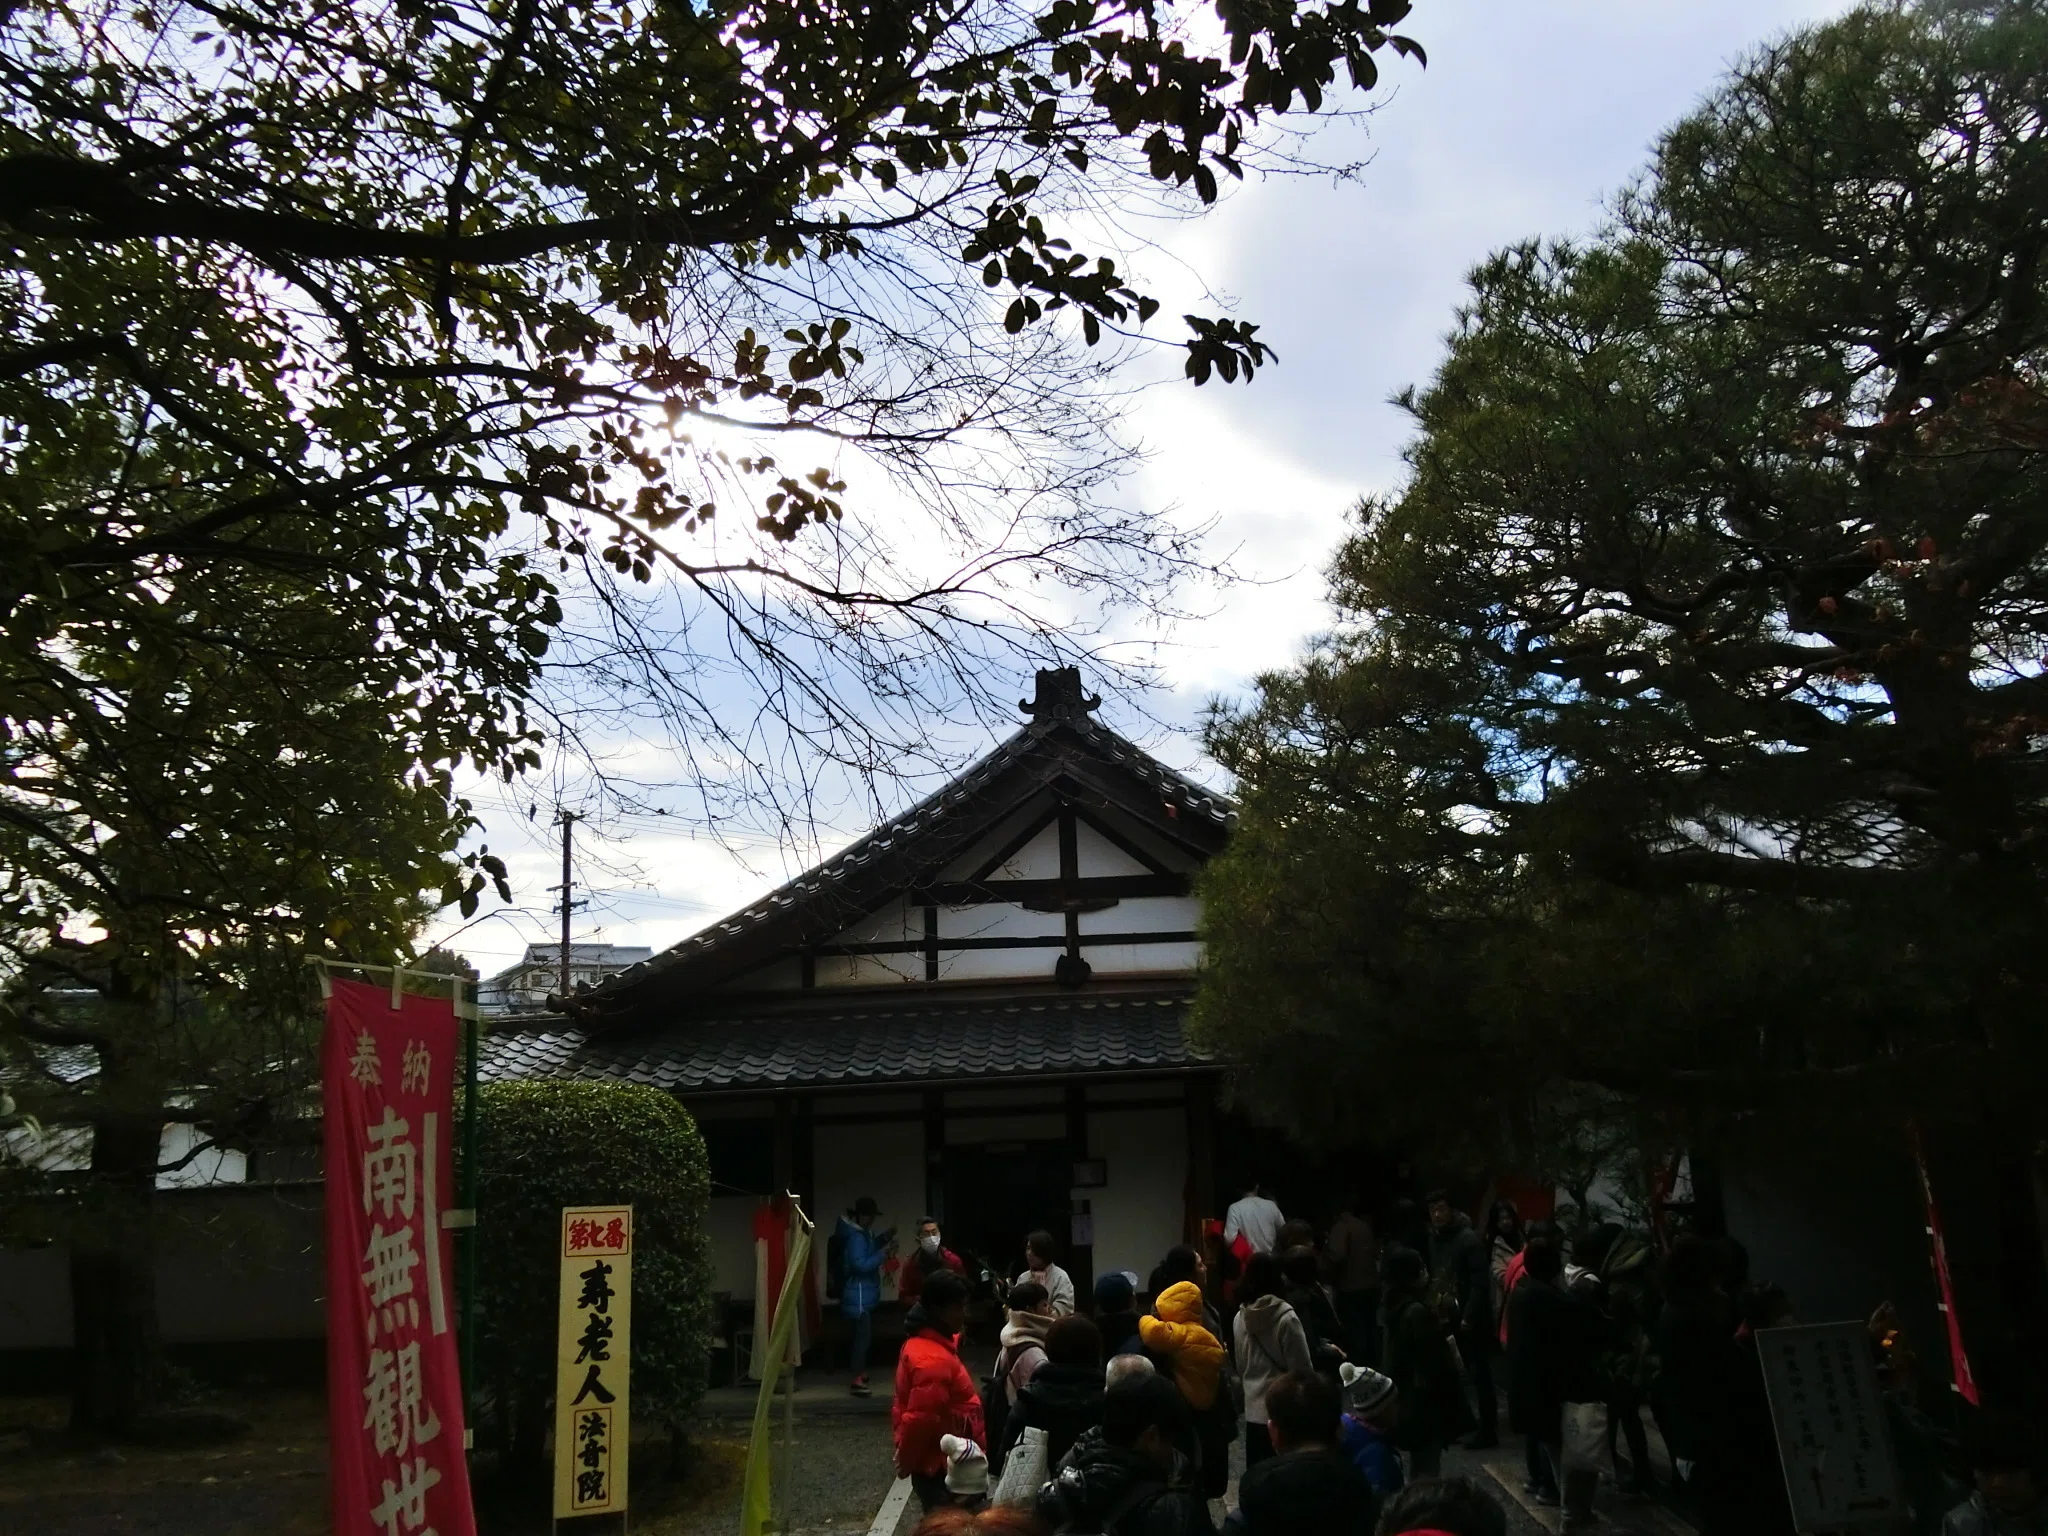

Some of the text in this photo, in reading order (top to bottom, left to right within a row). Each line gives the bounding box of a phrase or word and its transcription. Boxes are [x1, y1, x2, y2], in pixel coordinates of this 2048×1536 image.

[349, 1027, 433, 1097] 奉納
[568, 1217, 627, 1251] 第七番
[570, 1259, 616, 1406] 寿老人
[576, 1412, 608, 1504] 法音院
